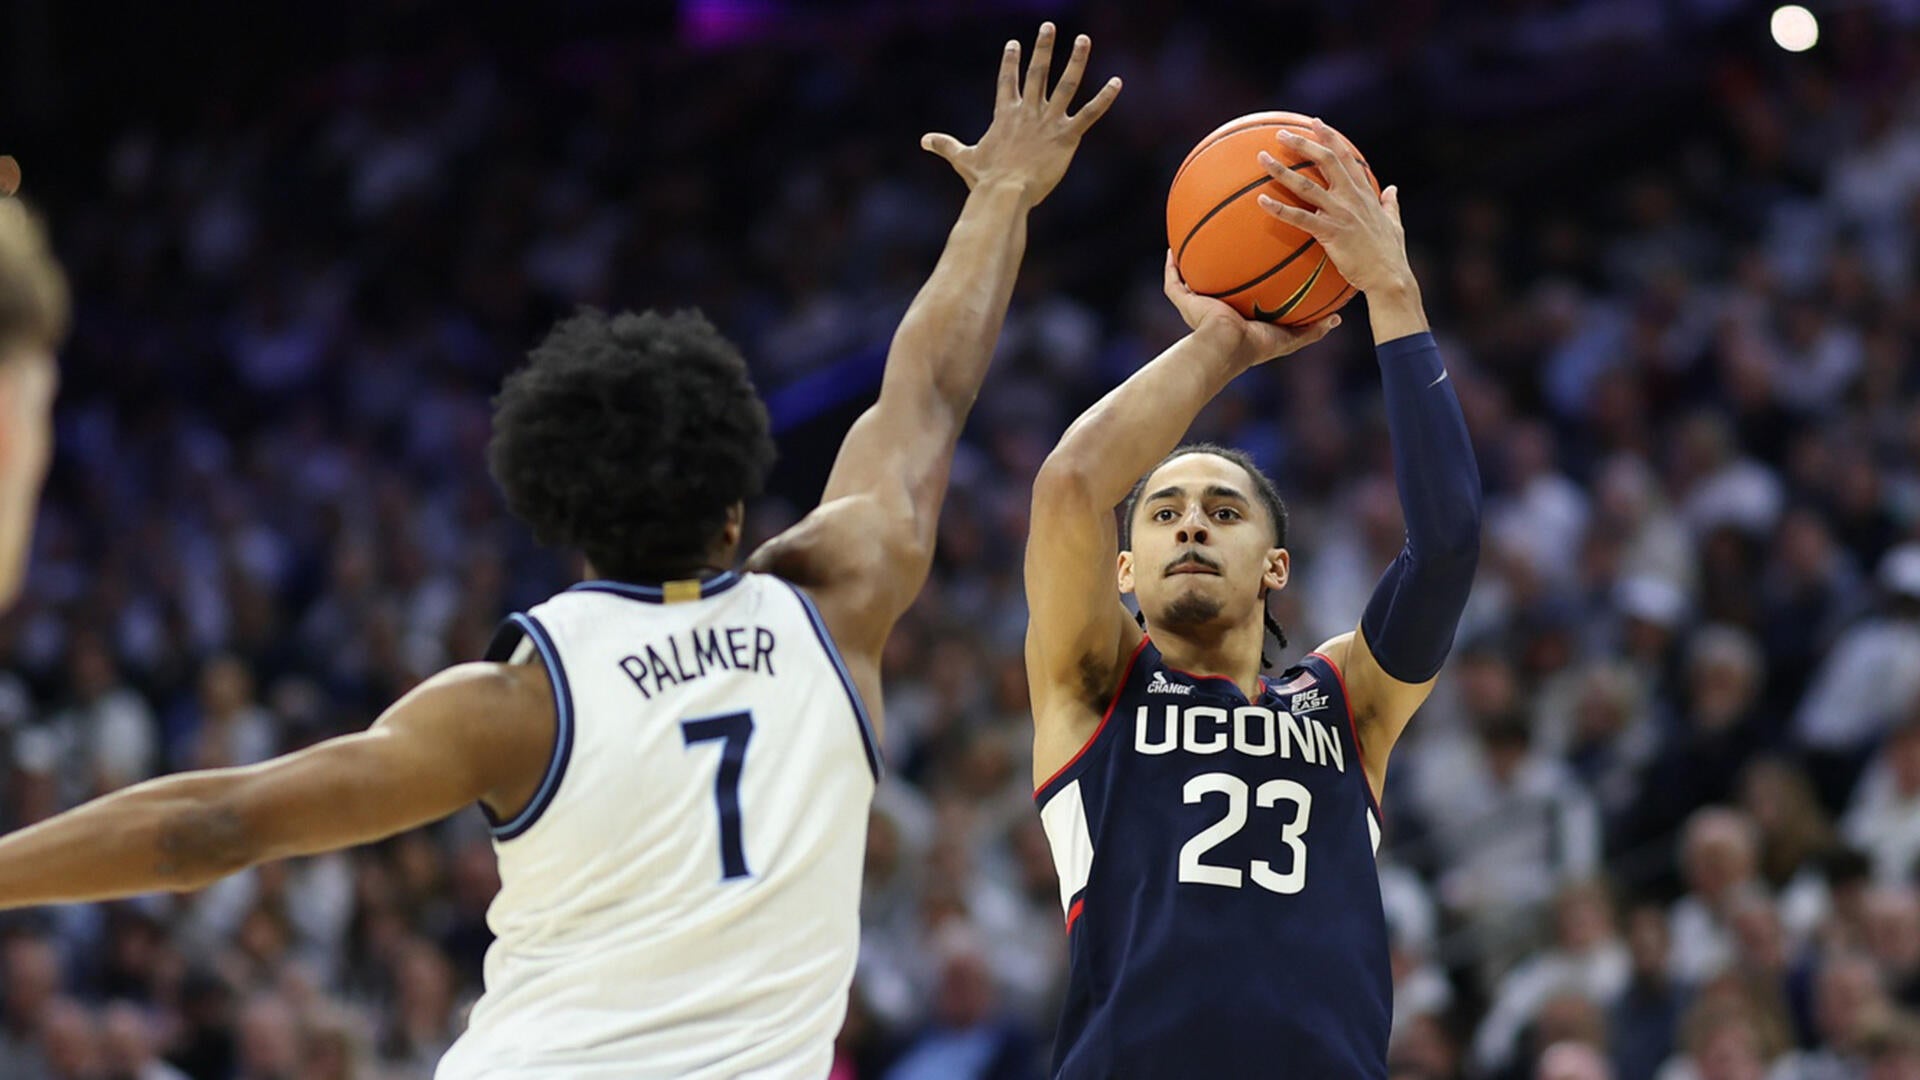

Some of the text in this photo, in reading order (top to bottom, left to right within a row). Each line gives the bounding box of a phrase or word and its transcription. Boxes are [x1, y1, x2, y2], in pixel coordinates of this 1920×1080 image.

[617, 626, 776, 700] PALMER
[1147, 682, 1193, 696] CHANGE
[1291, 688, 1319, 704] BIG
[1291, 695, 1329, 712] EAST
[1135, 704, 1344, 773] UCONN
[679, 708, 756, 882] 7
[1178, 772, 1312, 894] 23
